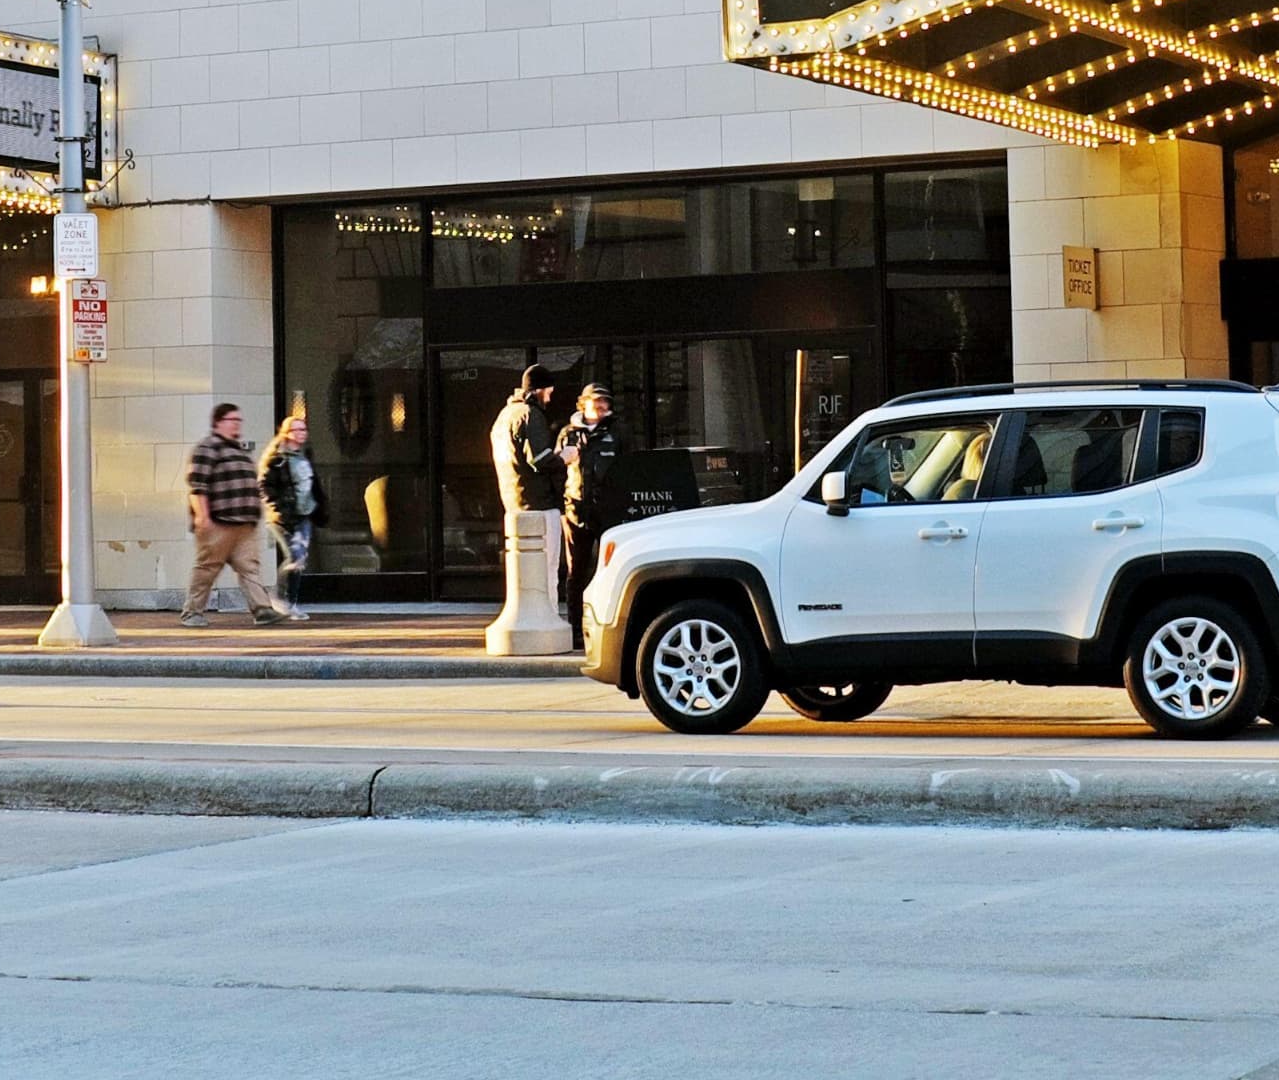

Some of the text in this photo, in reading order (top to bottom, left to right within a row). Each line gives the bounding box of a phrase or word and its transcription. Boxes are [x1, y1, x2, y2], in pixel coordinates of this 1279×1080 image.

[62, 220, 89, 229] VALET
[63, 230, 88, 239] ZONE
[1069, 278, 1092, 295] OFFICE
[78, 301, 101, 311] NO
[74, 311, 106, 322] PARKING
[631, 491, 673, 502] THANK
[640, 505, 666, 516] YOU
